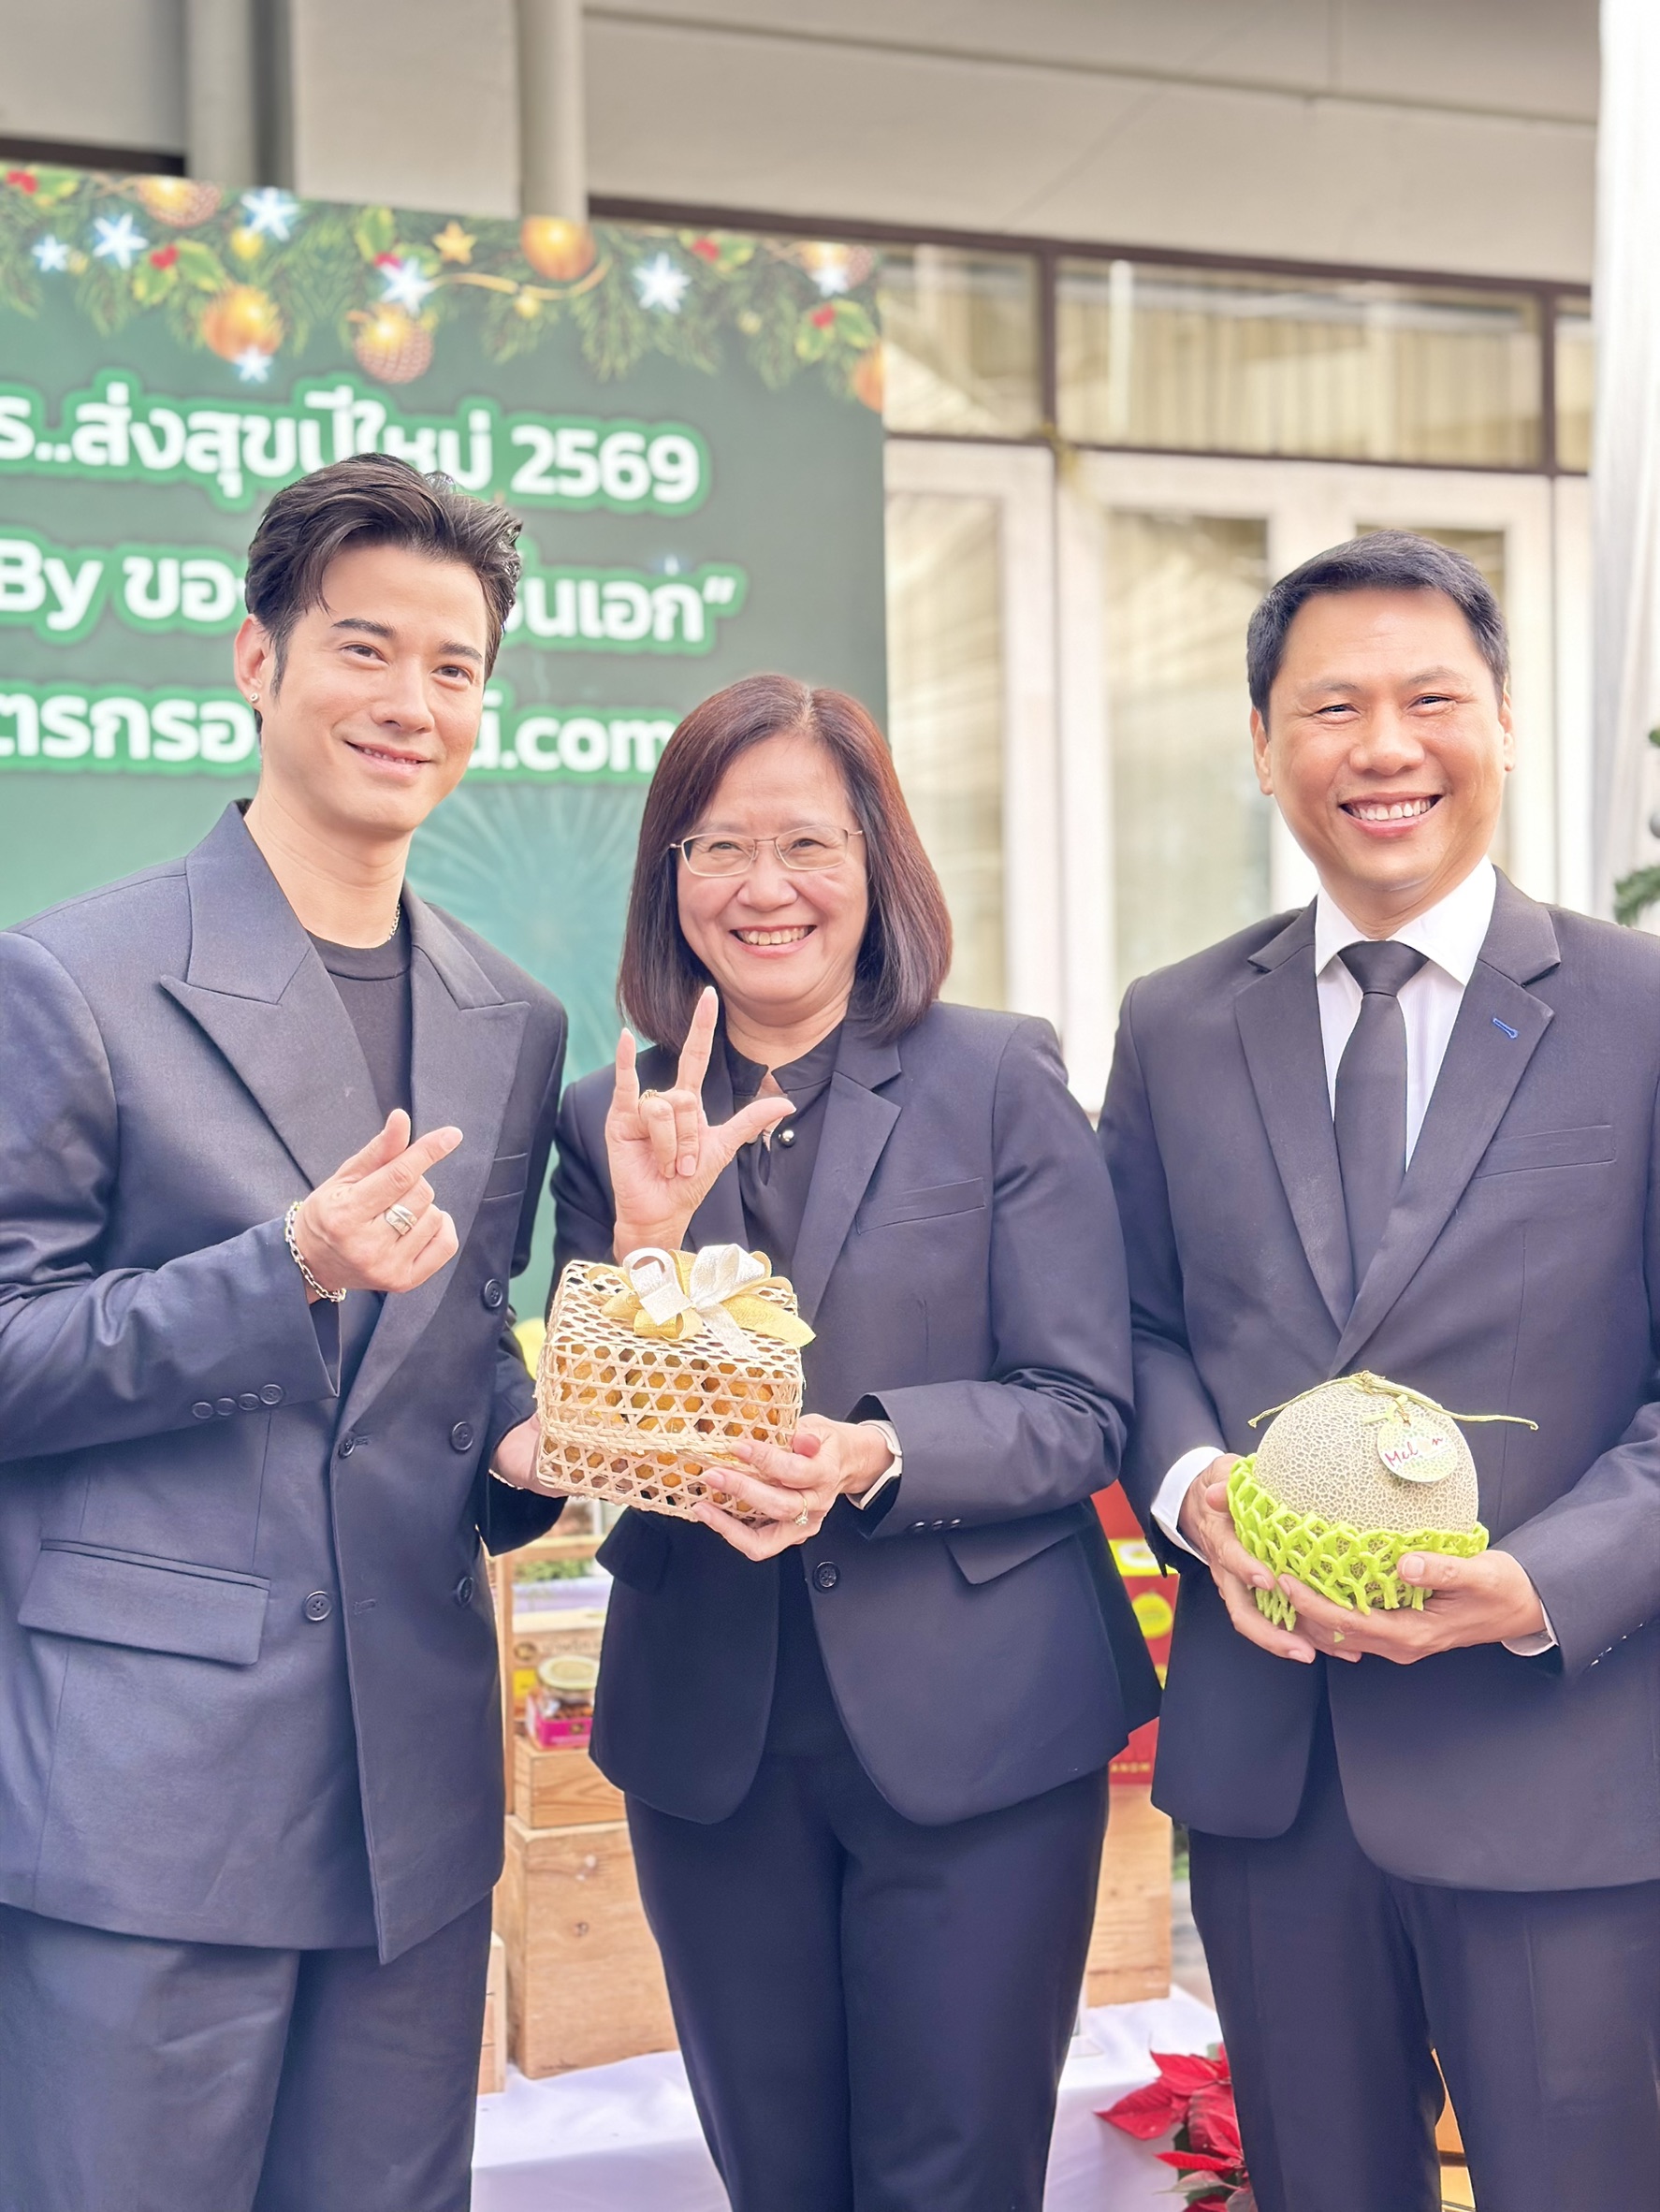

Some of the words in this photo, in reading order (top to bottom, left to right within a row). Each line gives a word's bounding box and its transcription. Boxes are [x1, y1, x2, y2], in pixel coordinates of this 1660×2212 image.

[511, 425, 700, 503] 2569
[0, 539, 103, 631] By
[124, 557, 246, 622] ขอ
[1384, 1437, 1444, 1467] Meln
